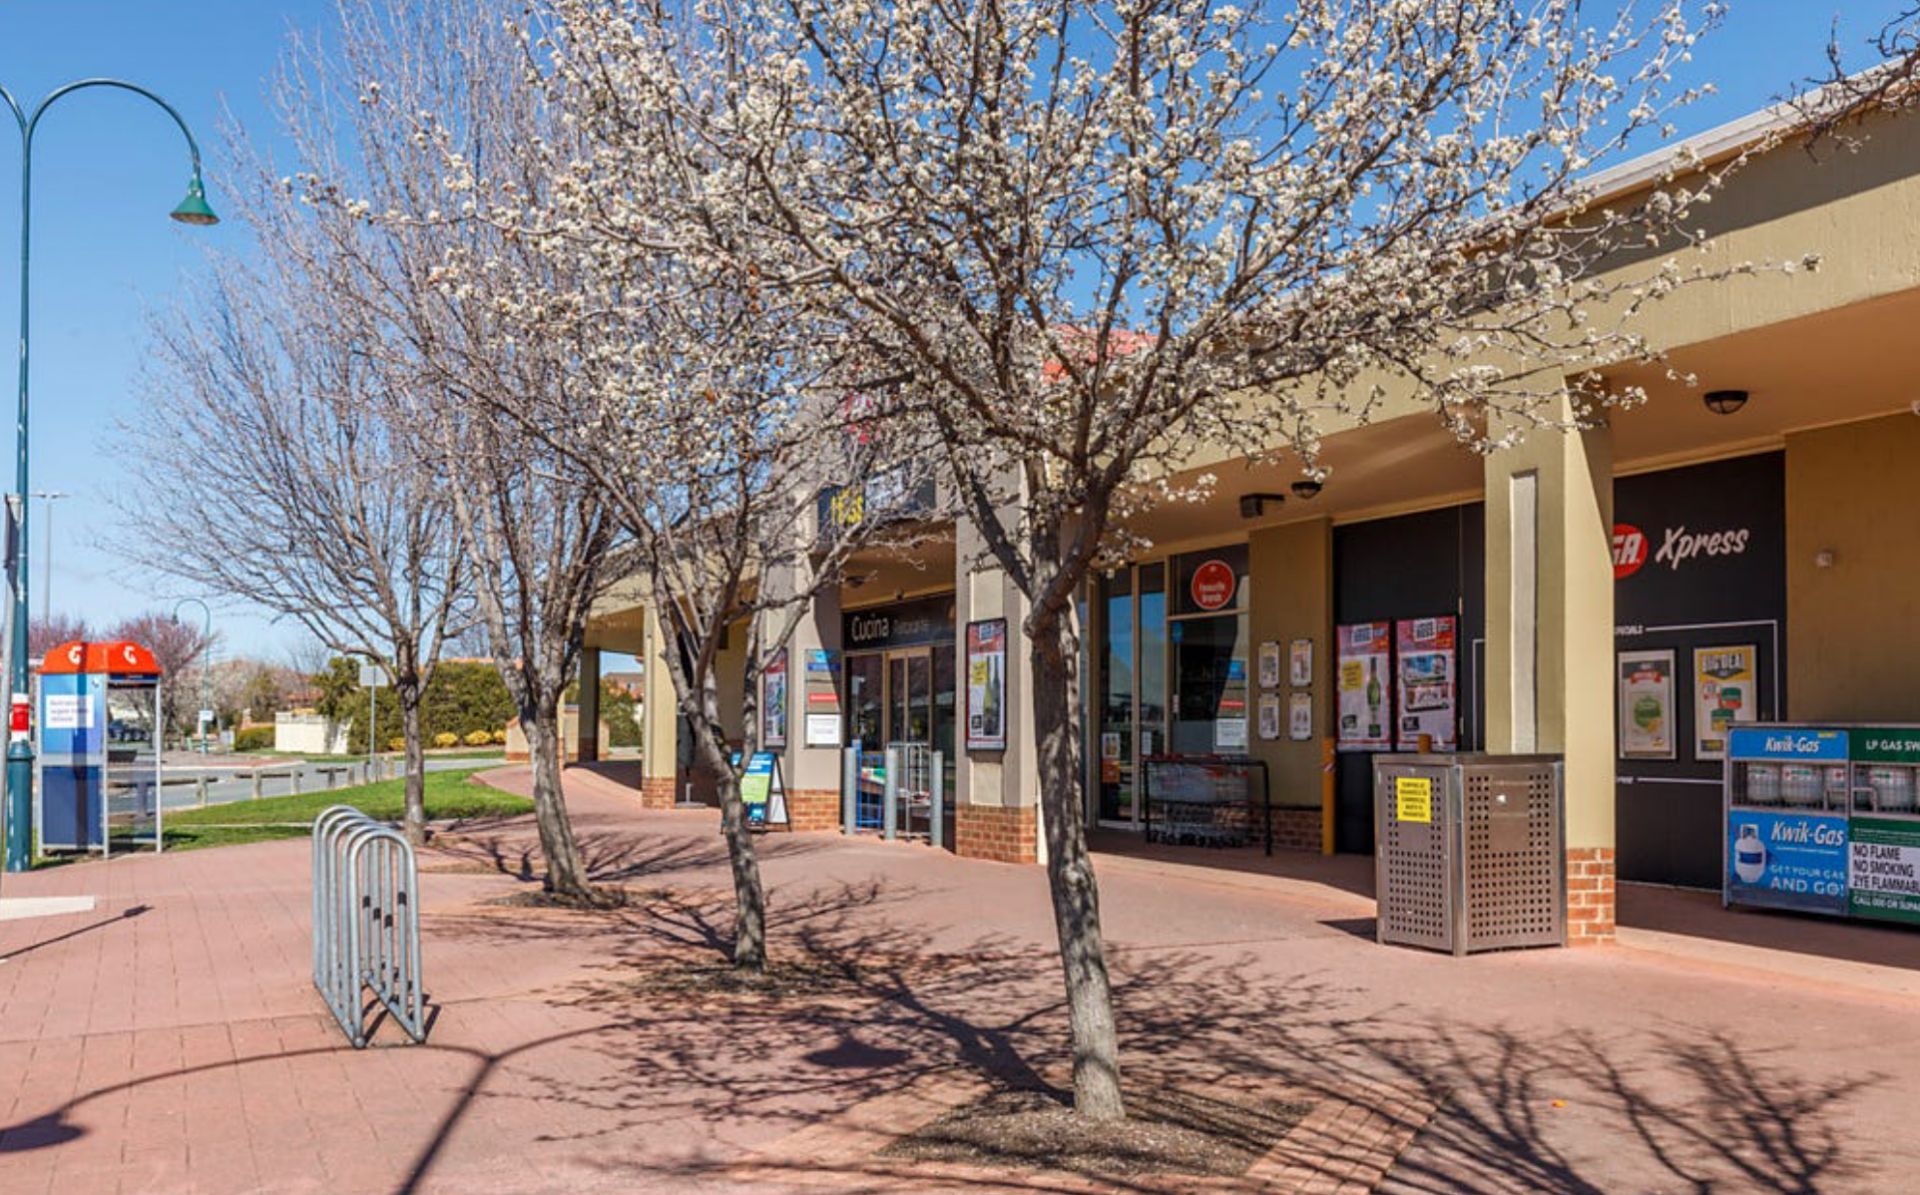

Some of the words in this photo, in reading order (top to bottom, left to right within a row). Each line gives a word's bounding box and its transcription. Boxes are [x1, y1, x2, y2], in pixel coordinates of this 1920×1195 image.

[1655, 525, 1750, 571] Xpress
[851, 612, 889, 641] Cucina
[1765, 734, 1820, 754] Kwik-Gas
[1866, 740, 1879, 750] LP
[1880, 740, 1902, 751] GAS
[1771, 821, 1845, 847] Kwik-Gas
[1853, 843, 1869, 858] NO
[1870, 845, 1901, 861] FLAME
[1792, 866, 1820, 877] YOUR
[1823, 869, 1845, 880] GAS
[1853, 859, 1869, 873] NO
[1870, 861, 1914, 877] SMOKING
[1771, 875, 1808, 892] AND
[1814, 880, 1845, 897] GO!
